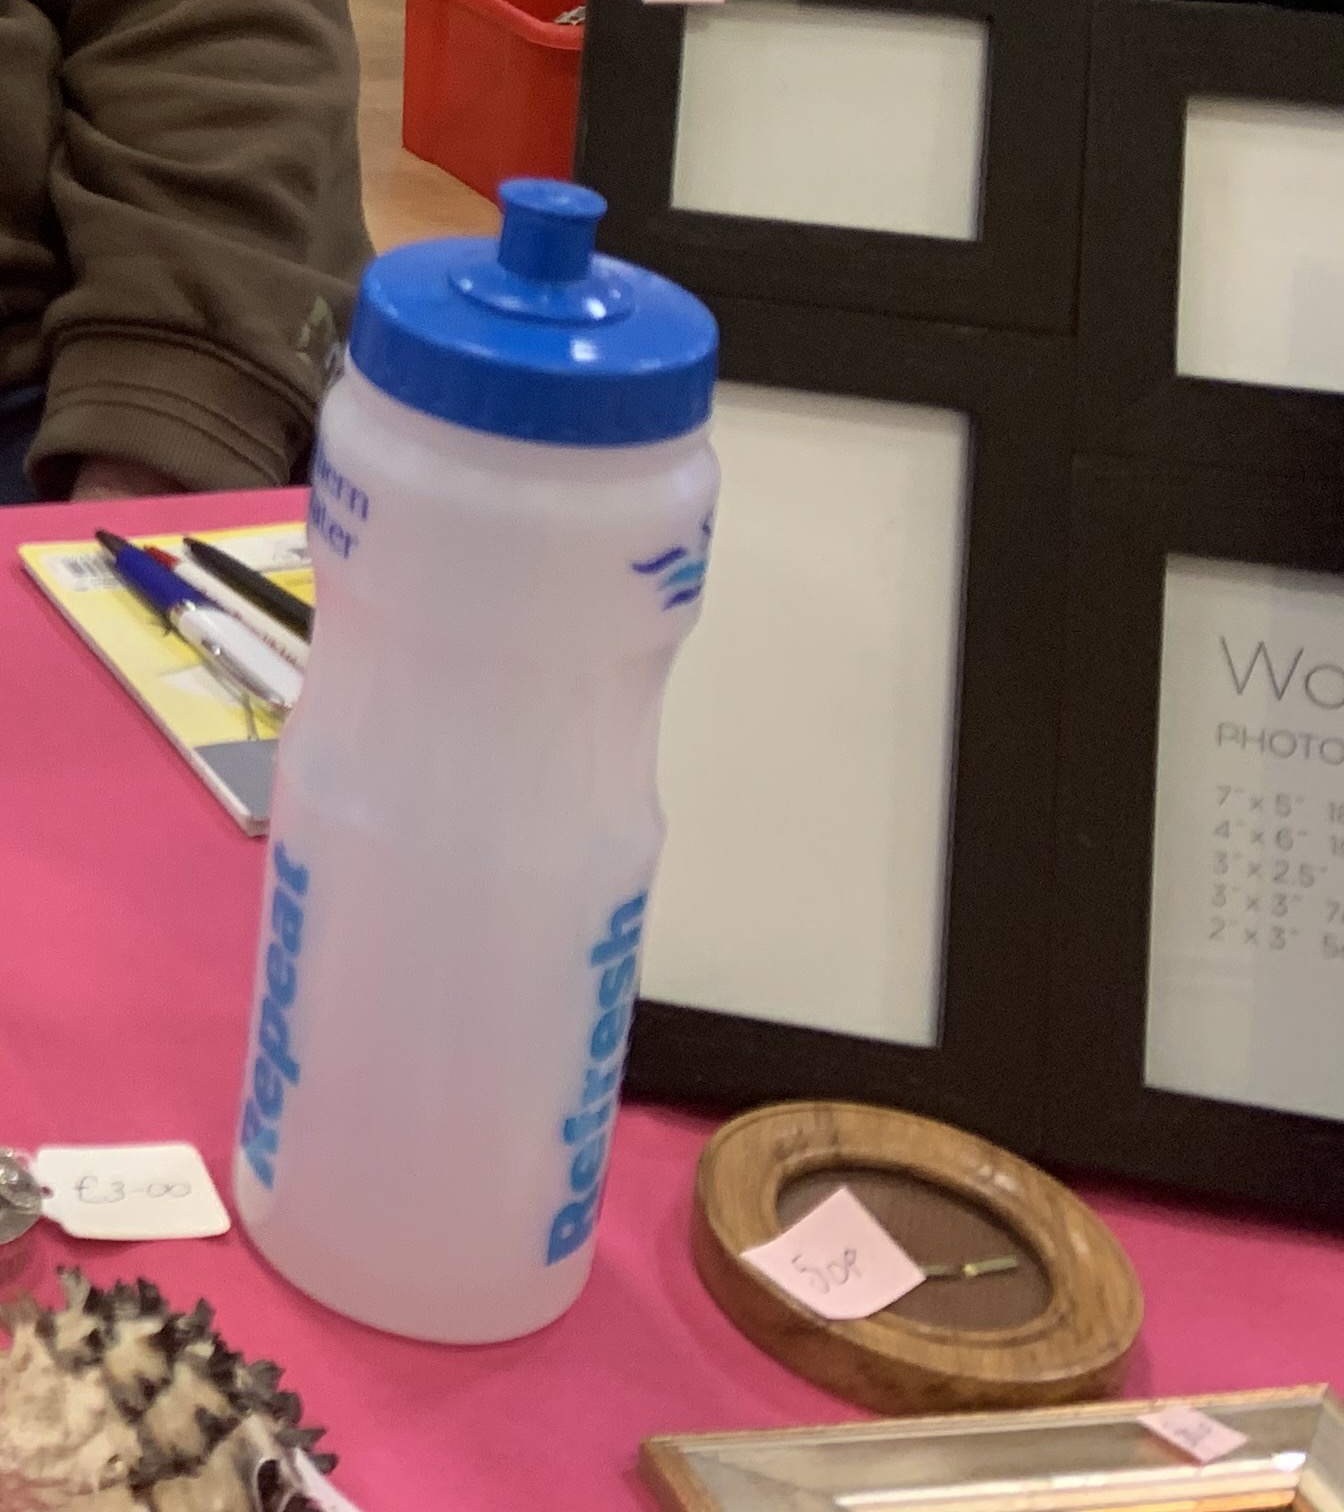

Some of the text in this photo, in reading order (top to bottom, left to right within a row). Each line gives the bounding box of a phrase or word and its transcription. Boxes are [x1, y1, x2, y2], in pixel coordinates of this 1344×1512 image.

[1249, 795, 1263, 812] x
[1250, 828, 1264, 845] x
[1247, 862, 1262, 879] x
[1246, 894, 1260, 912] x
[1243, 927, 1258, 945] x
[240, 839, 310, 1191] Repeat
[544, 888, 650, 1268] Refresh
